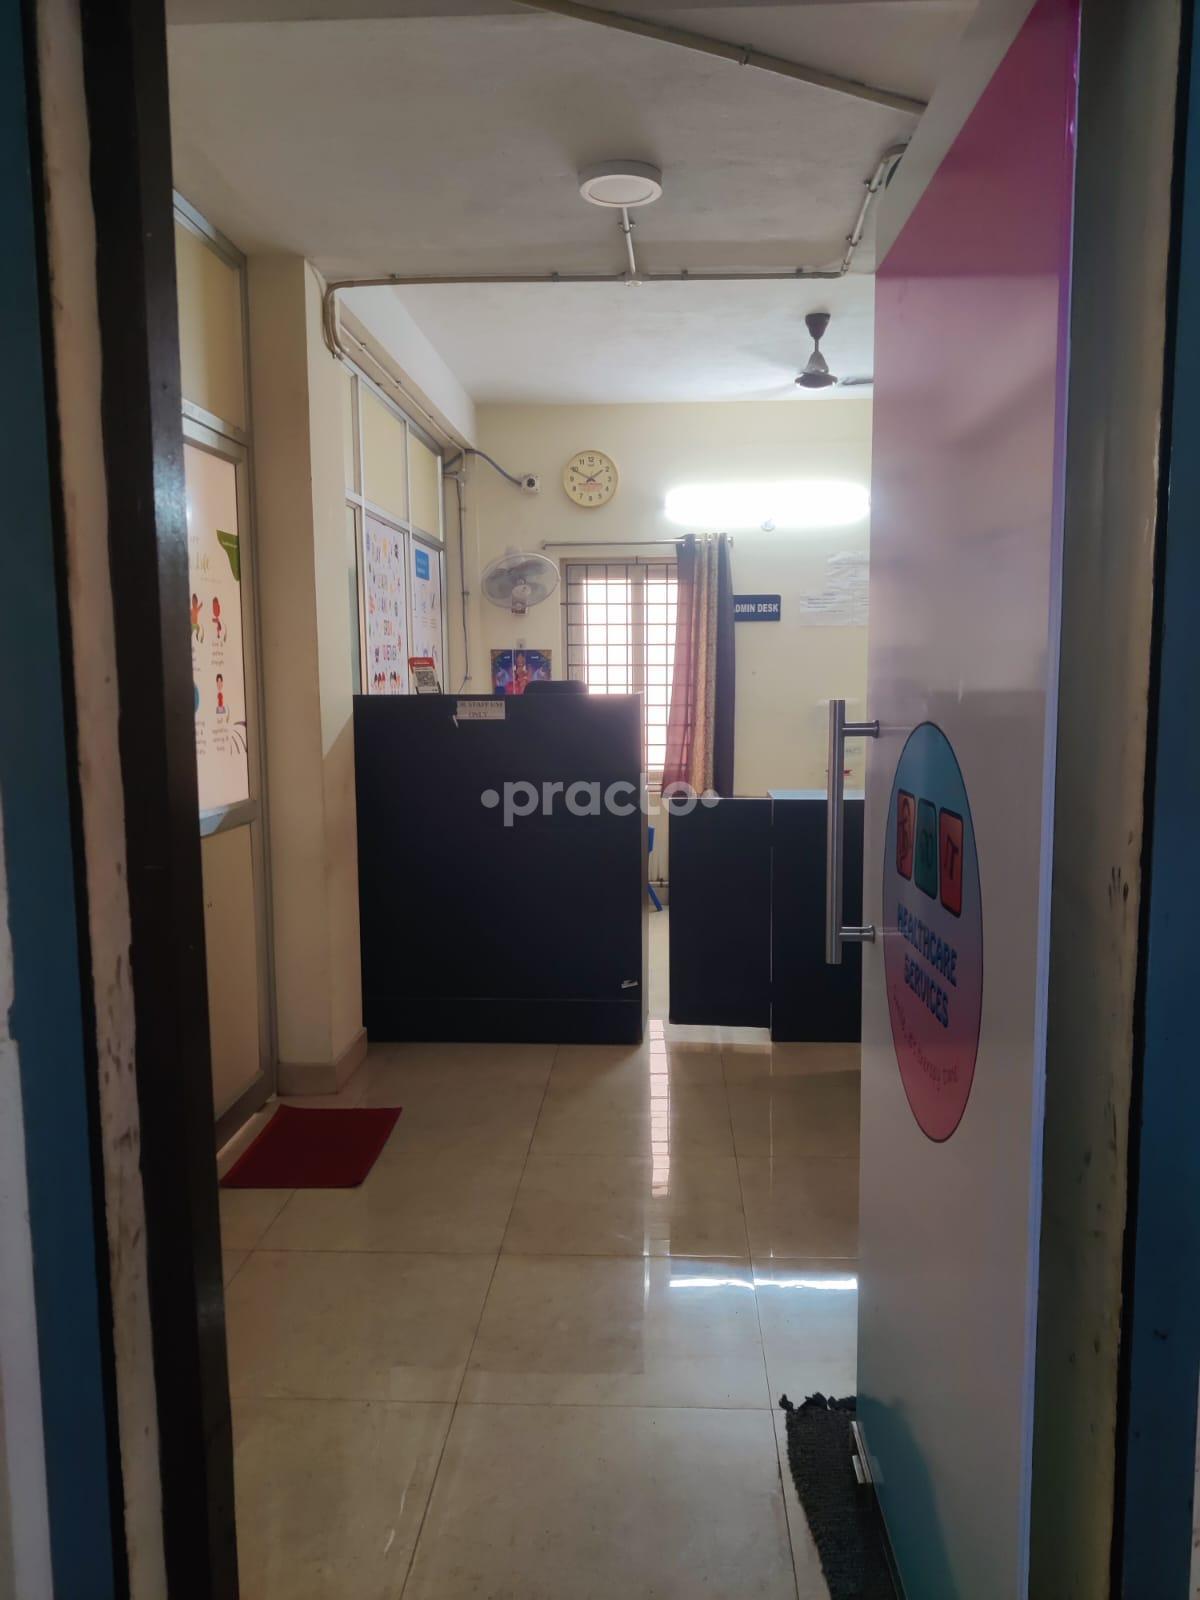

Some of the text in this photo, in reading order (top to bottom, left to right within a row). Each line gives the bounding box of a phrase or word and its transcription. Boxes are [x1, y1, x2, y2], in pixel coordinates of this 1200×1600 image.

[733, 603, 778, 613] DMIN DESK
[897, 903, 958, 988] HEALTHCARE
[904, 953, 949, 1029] SERVICES
